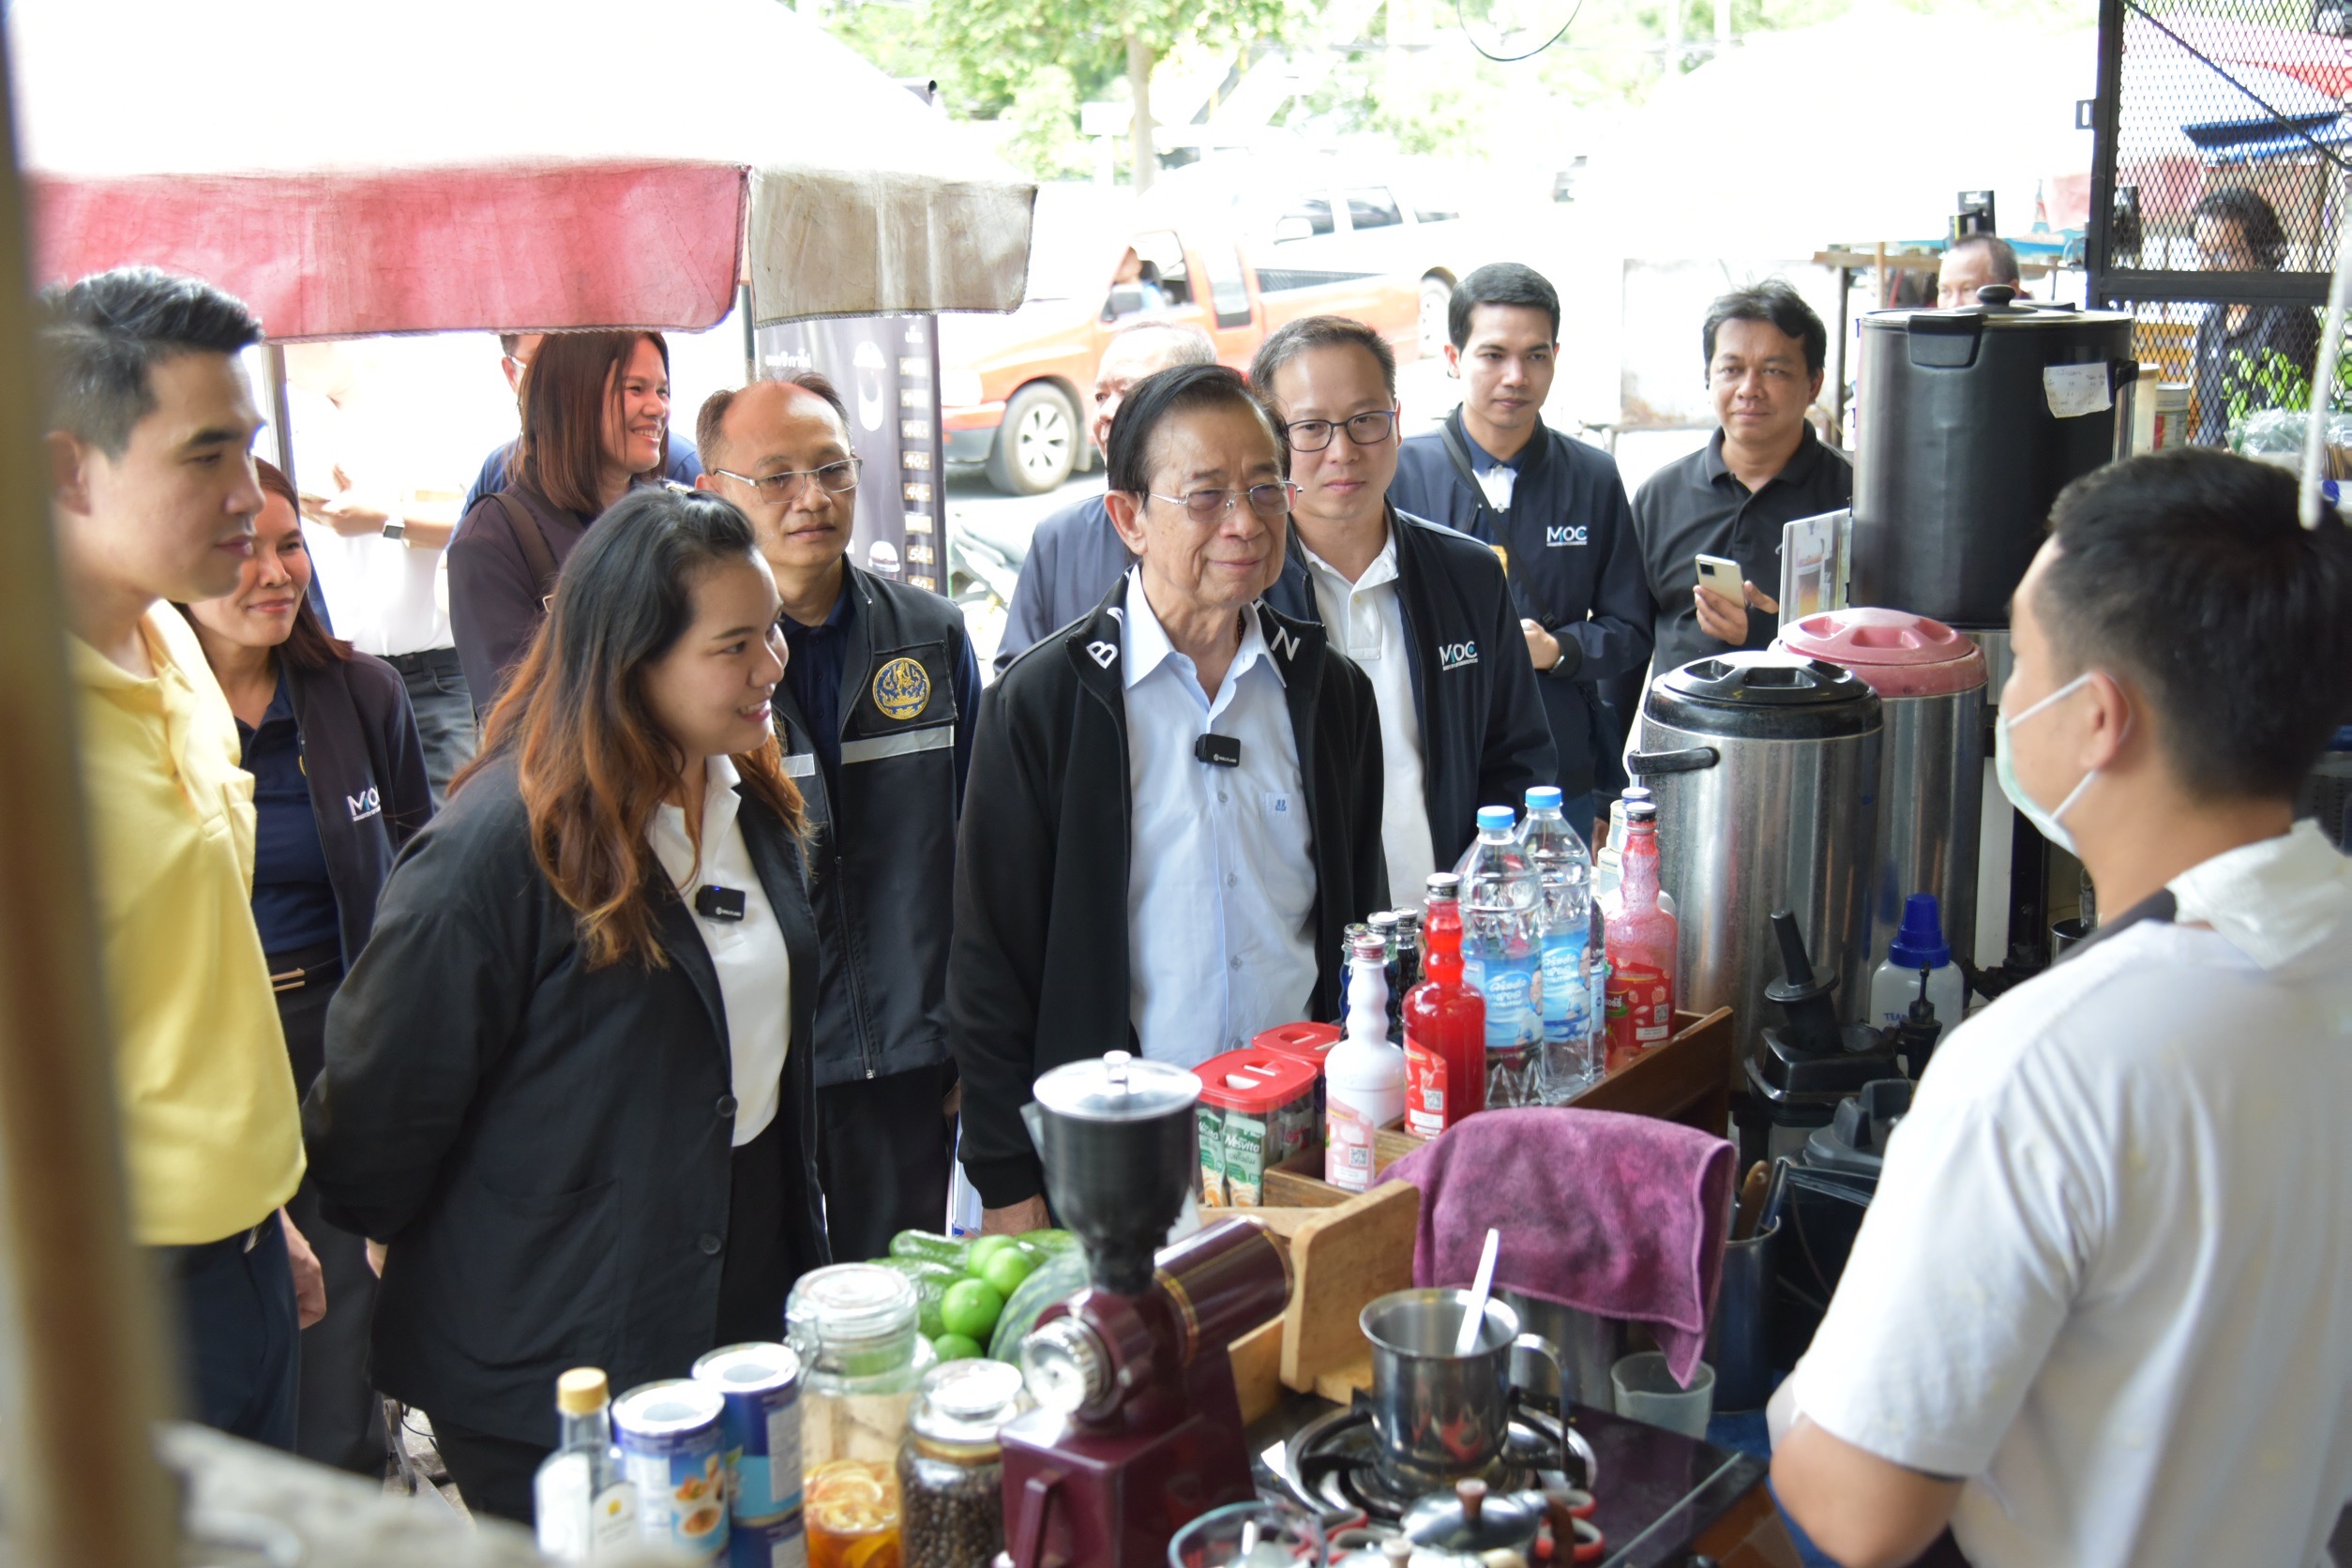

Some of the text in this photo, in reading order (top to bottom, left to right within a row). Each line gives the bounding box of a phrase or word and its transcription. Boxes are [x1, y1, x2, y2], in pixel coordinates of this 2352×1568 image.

[1546, 525, 1587, 542] MOC
[1439, 641, 1477, 666] MOC
[347, 785, 380, 816] MO
[1225, 1133, 1260, 1154] Nesvita
